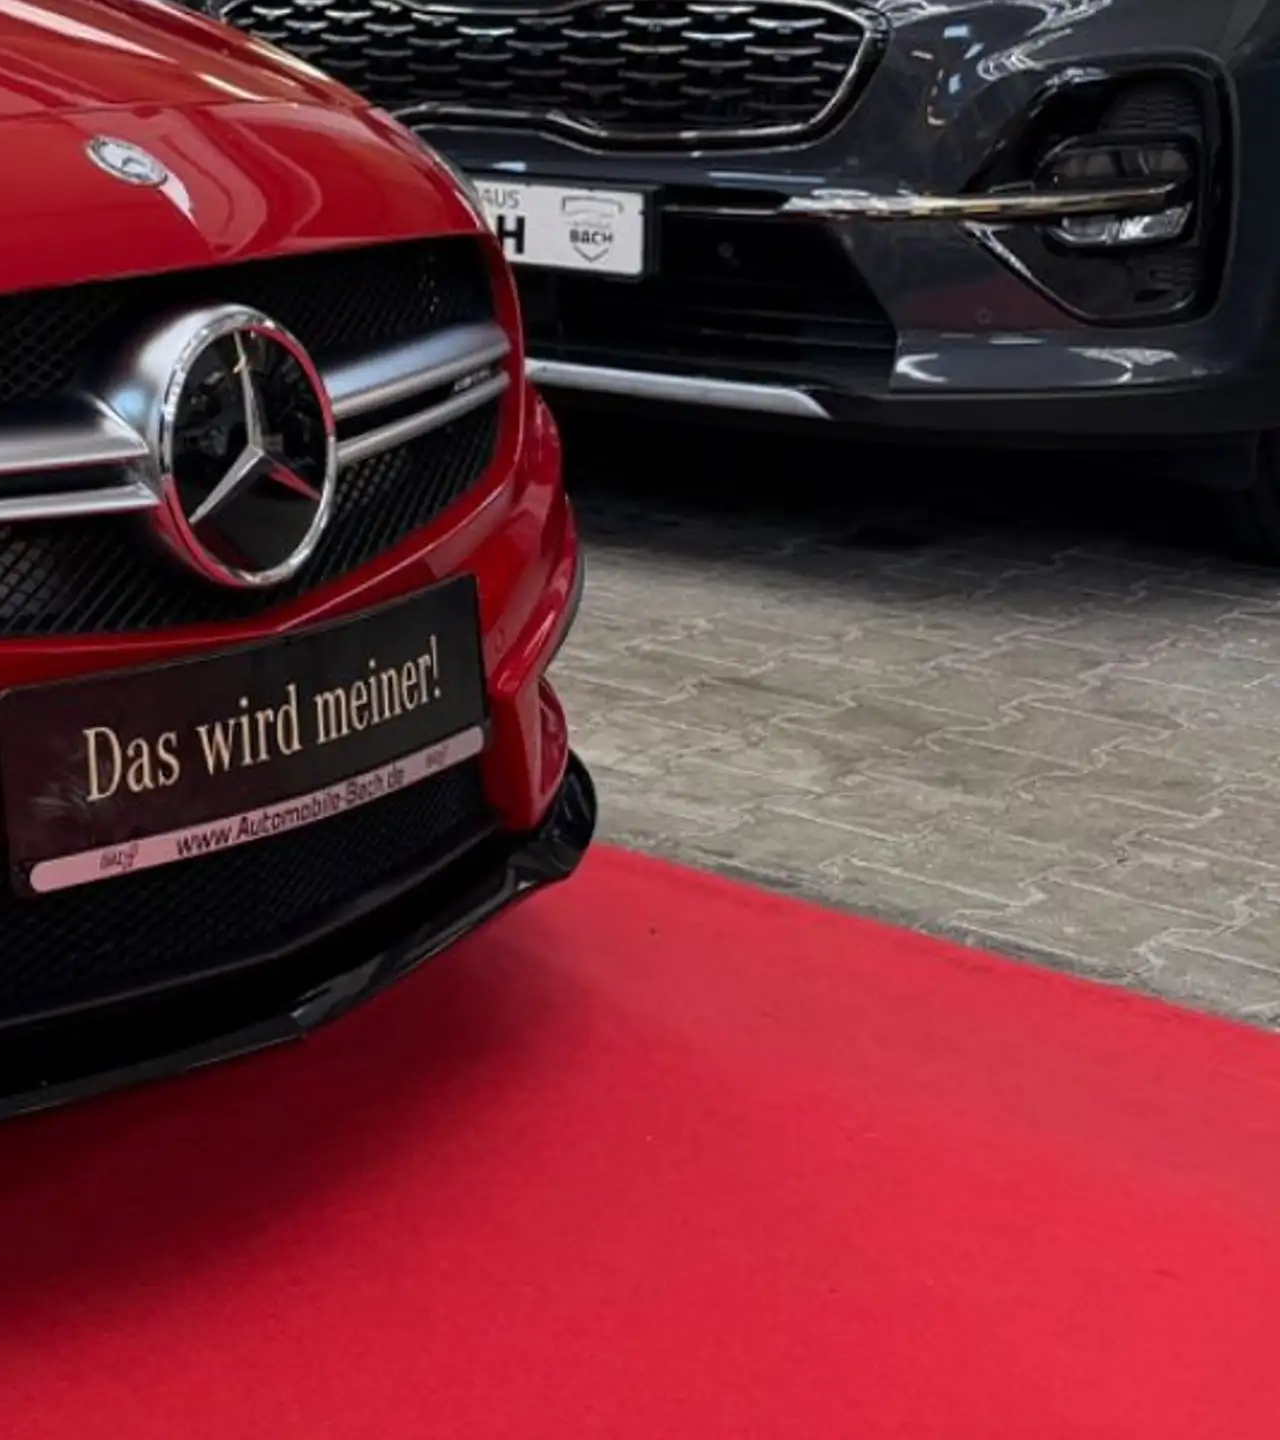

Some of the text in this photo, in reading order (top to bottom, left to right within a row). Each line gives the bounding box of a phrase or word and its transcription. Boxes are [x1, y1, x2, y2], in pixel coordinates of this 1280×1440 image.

[570, 228, 614, 245] BACH
[82, 633, 442, 802] Das wird meiner!
